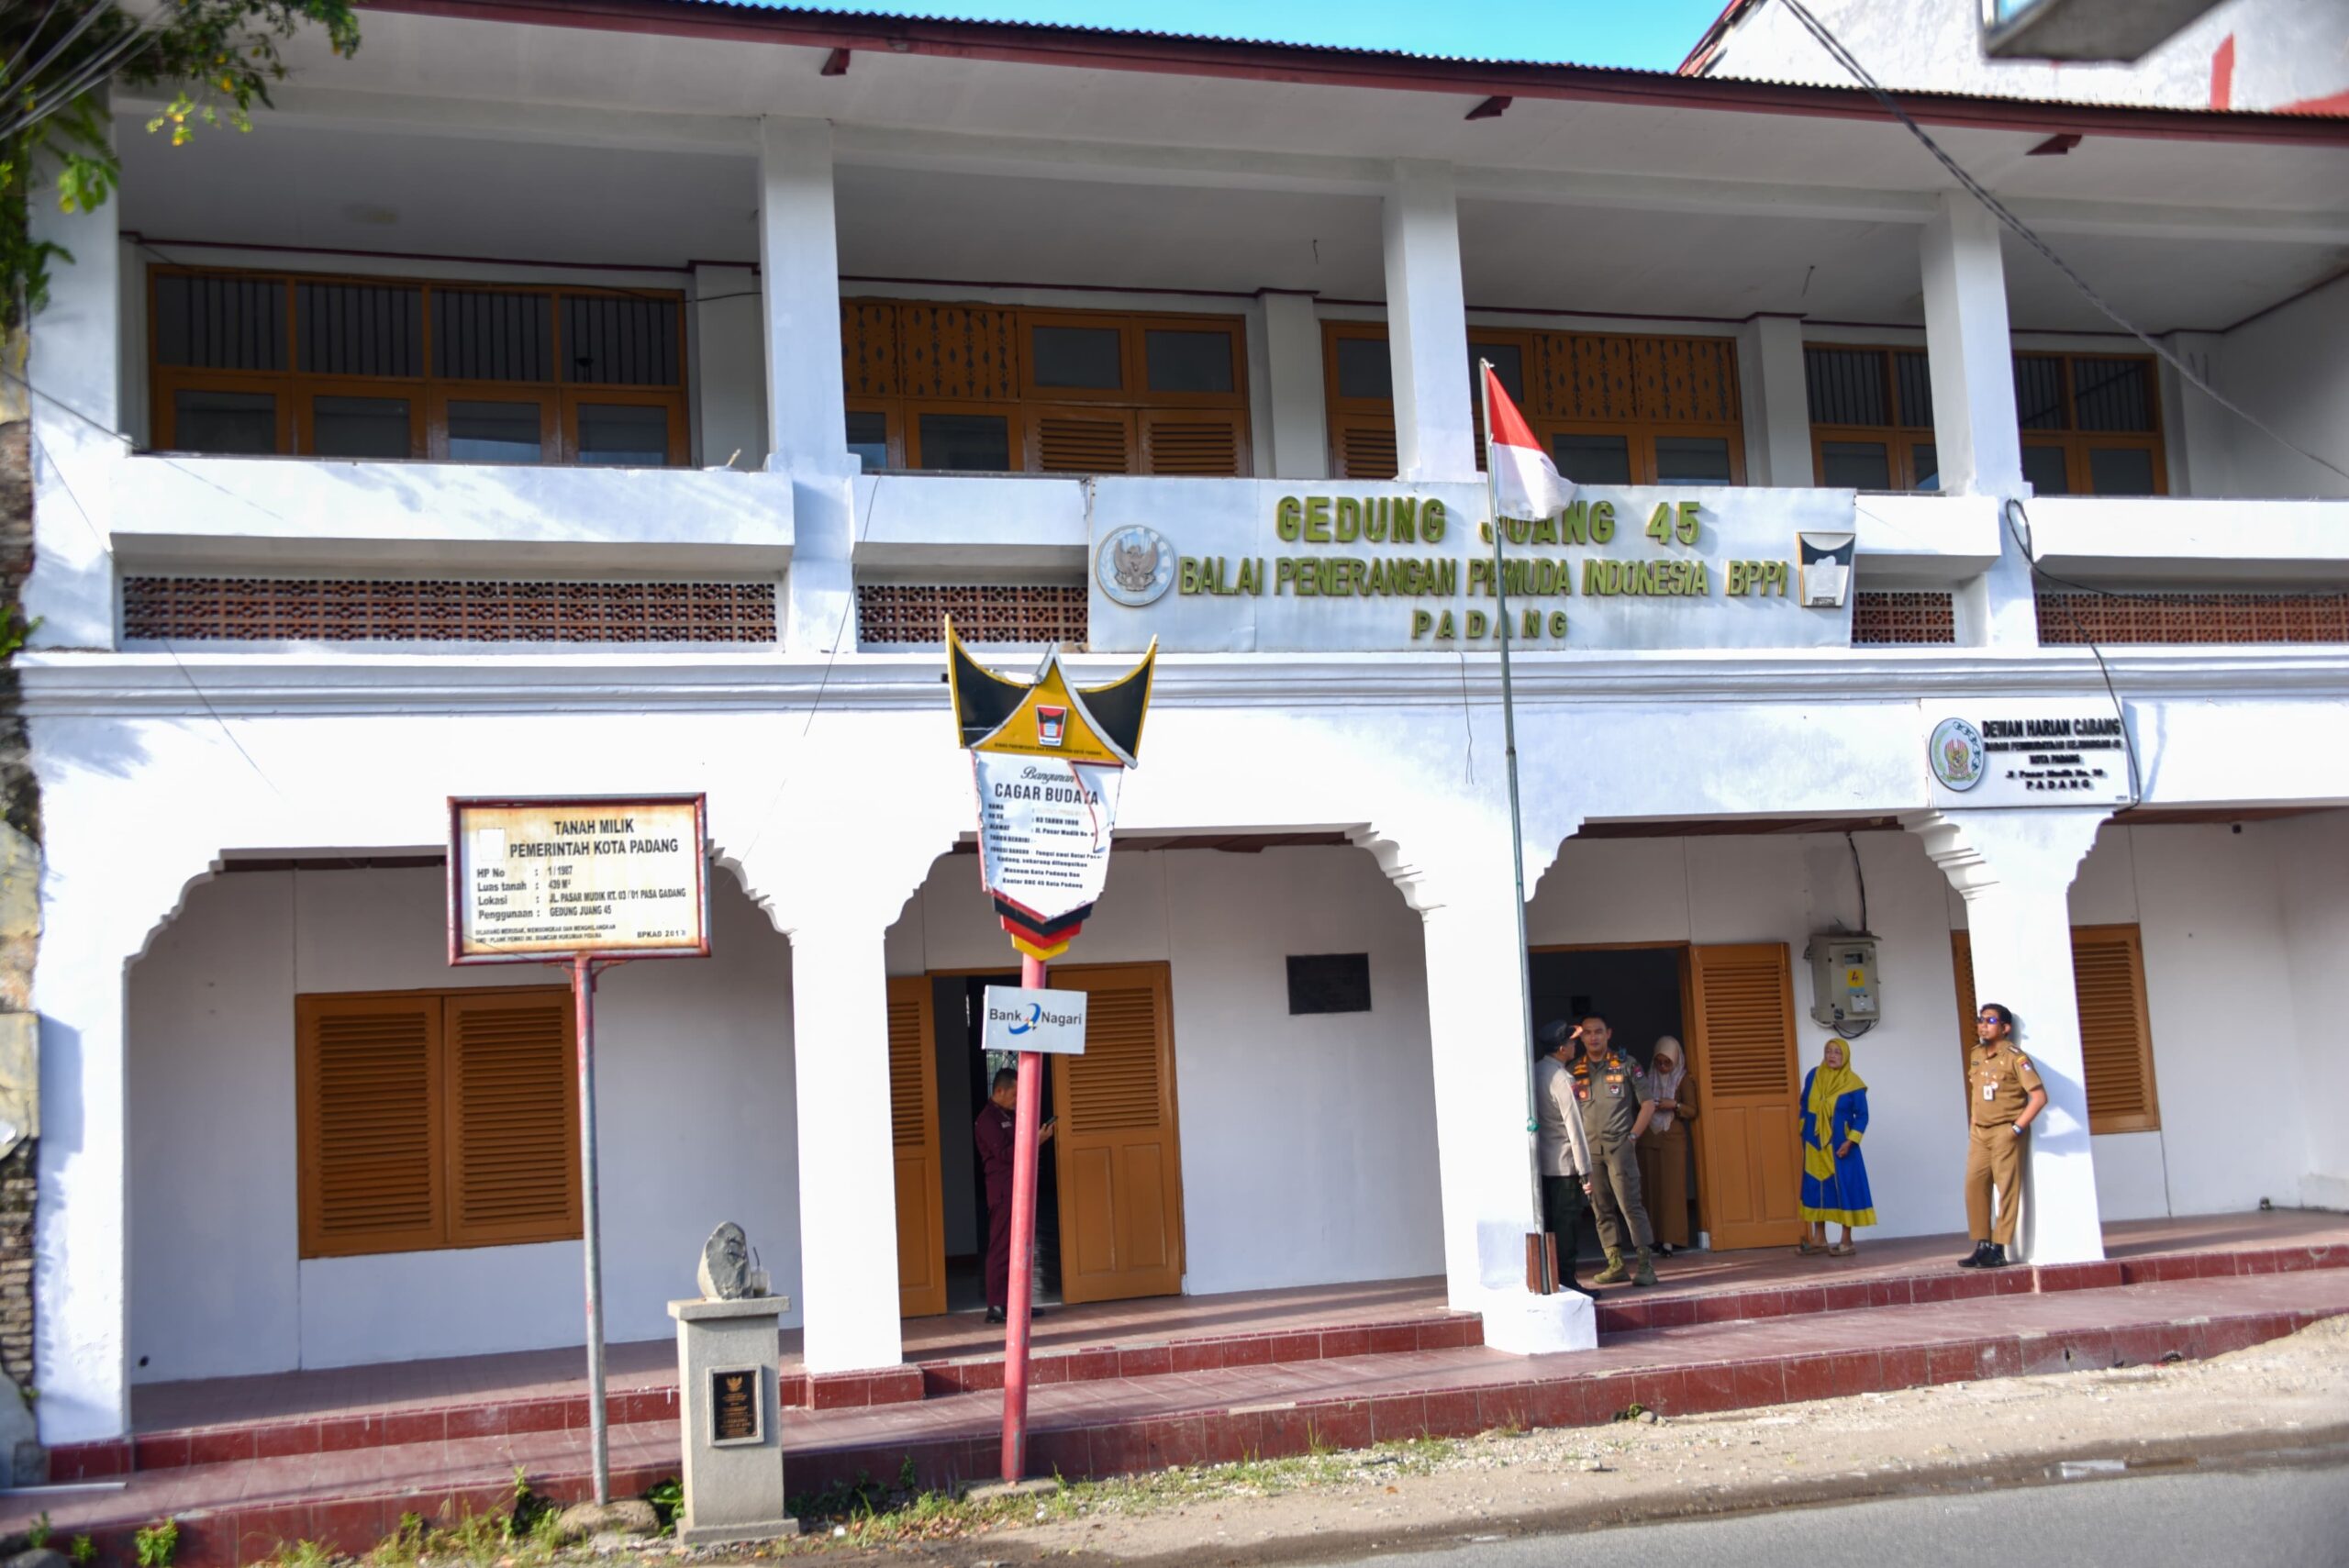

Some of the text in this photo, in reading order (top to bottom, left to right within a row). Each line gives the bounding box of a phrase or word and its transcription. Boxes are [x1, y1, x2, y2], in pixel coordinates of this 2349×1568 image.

[1275, 495, 1446, 543] GEDUNG
[1645, 501, 1700, 545] 45
[1178, 557, 1788, 597] BALAI PENERANGAN PEMUDA INDONESIA BPPI
[1410, 609, 1567, 639] PADANG
[1982, 717, 2121, 738] DEWAN HARIAN CABANG
[2029, 754, 2080, 764] KOTA PADANG
[1020, 765, 1075, 784] Bangunan
[2026, 780, 2090, 790] PADANG
[995, 783, 1099, 806] CAGAR BUDAYA
[554, 818, 634, 836] TANAH MILIK
[509, 839, 679, 858] PEMERINTAH KOTA PADANG
[1022, 858, 1051, 866] sekarang
[476, 868, 490, 878] HP
[492, 868, 506, 878] No
[1045, 869, 1068, 878] Padang
[477, 882, 499, 892] Luas
[501, 881, 528, 892] tanah
[1061, 880, 1084, 889] Padang
[477, 895, 508, 906] Lokasi
[561, 892, 583, 903] PASAR
[584, 891, 606, 902] MUDIK
[640, 889, 658, 899] PASA
[658, 888, 686, 899] GADANG
[478, 909, 533, 922] Penggunaan
[550, 906, 578, 917] GEDUNG
[579, 905, 603, 917] JUANG
[603, 905, 612, 915] 45
[989, 1007, 1082, 1027] Bank Nagari
